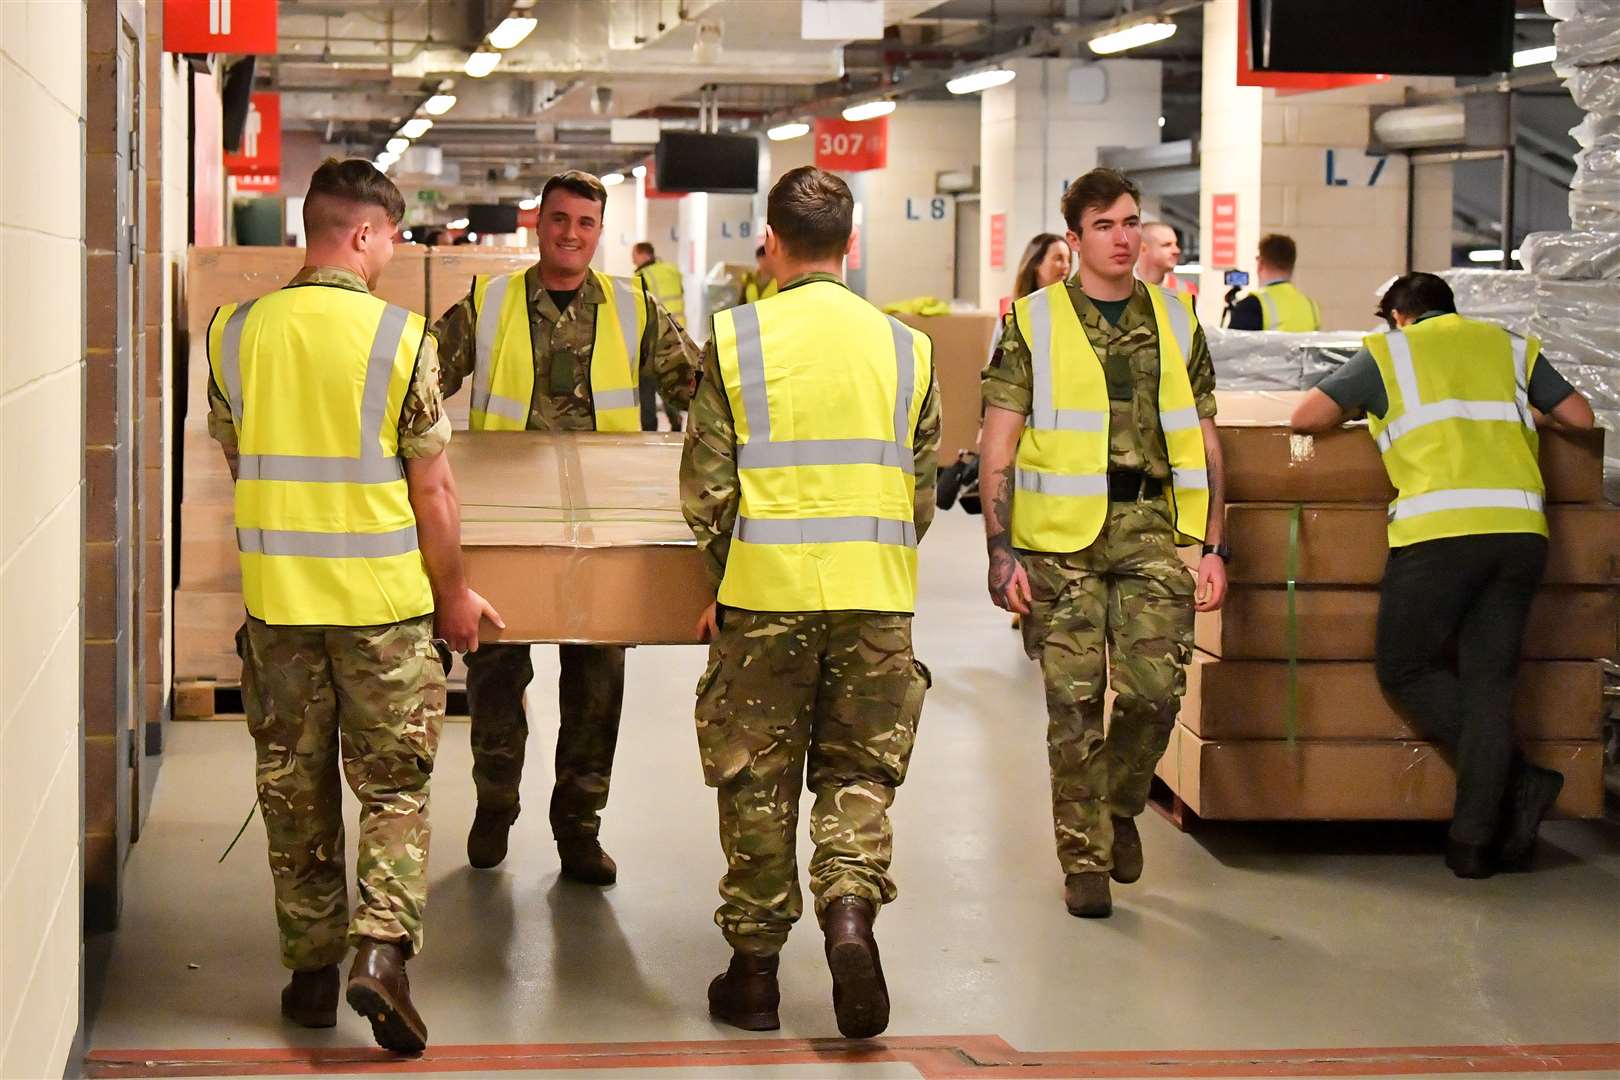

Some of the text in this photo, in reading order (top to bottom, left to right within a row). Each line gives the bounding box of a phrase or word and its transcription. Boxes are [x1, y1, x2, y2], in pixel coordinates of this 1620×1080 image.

[820, 132, 864, 156] 307
[1326, 149, 1387, 186] L 7
[906, 197, 945, 220] L 8
